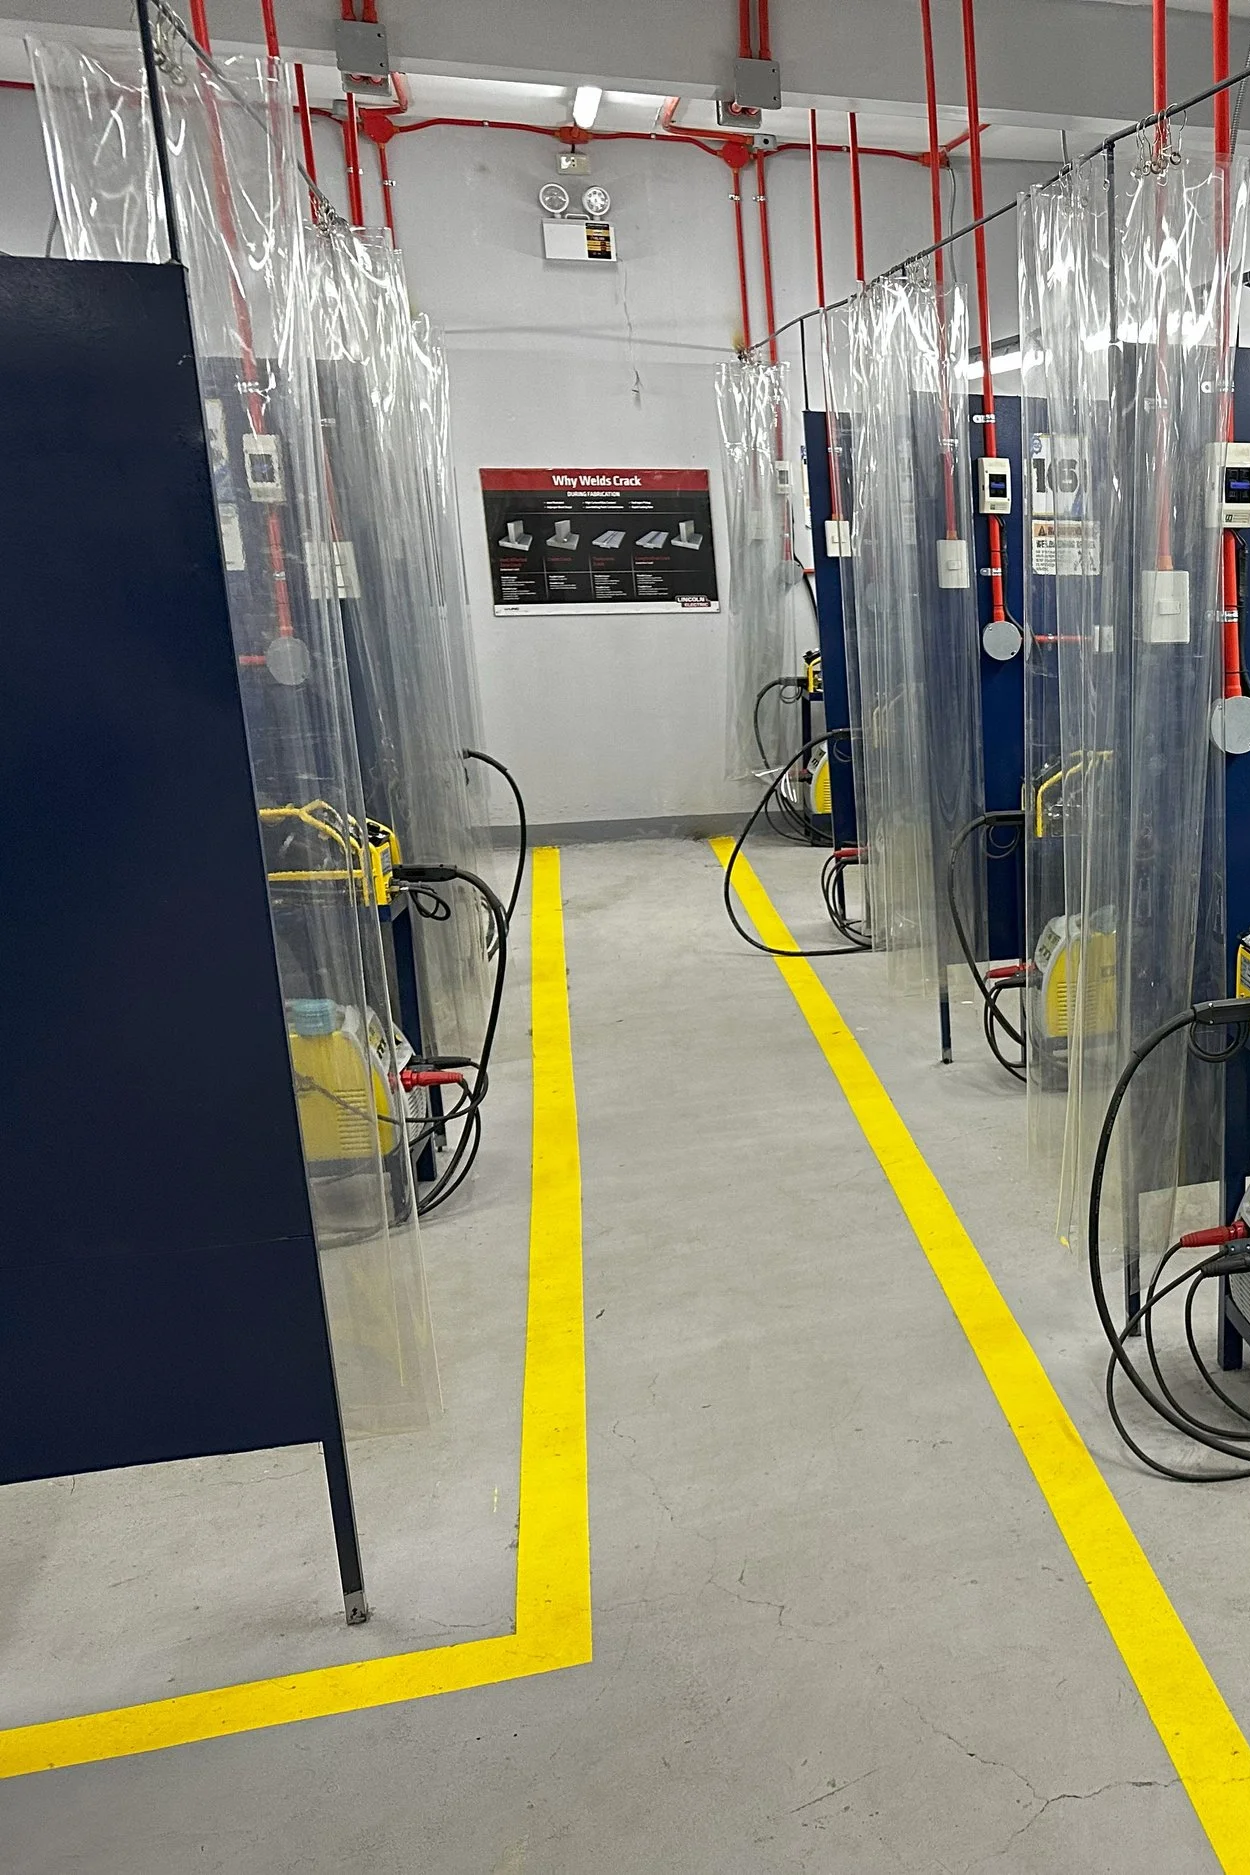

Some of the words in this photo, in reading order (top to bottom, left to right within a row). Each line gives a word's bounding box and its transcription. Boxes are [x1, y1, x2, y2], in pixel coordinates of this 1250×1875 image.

[552, 475, 577, 488] Why
[579, 475, 611, 486] Welds
[613, 475, 642, 486] Crack
